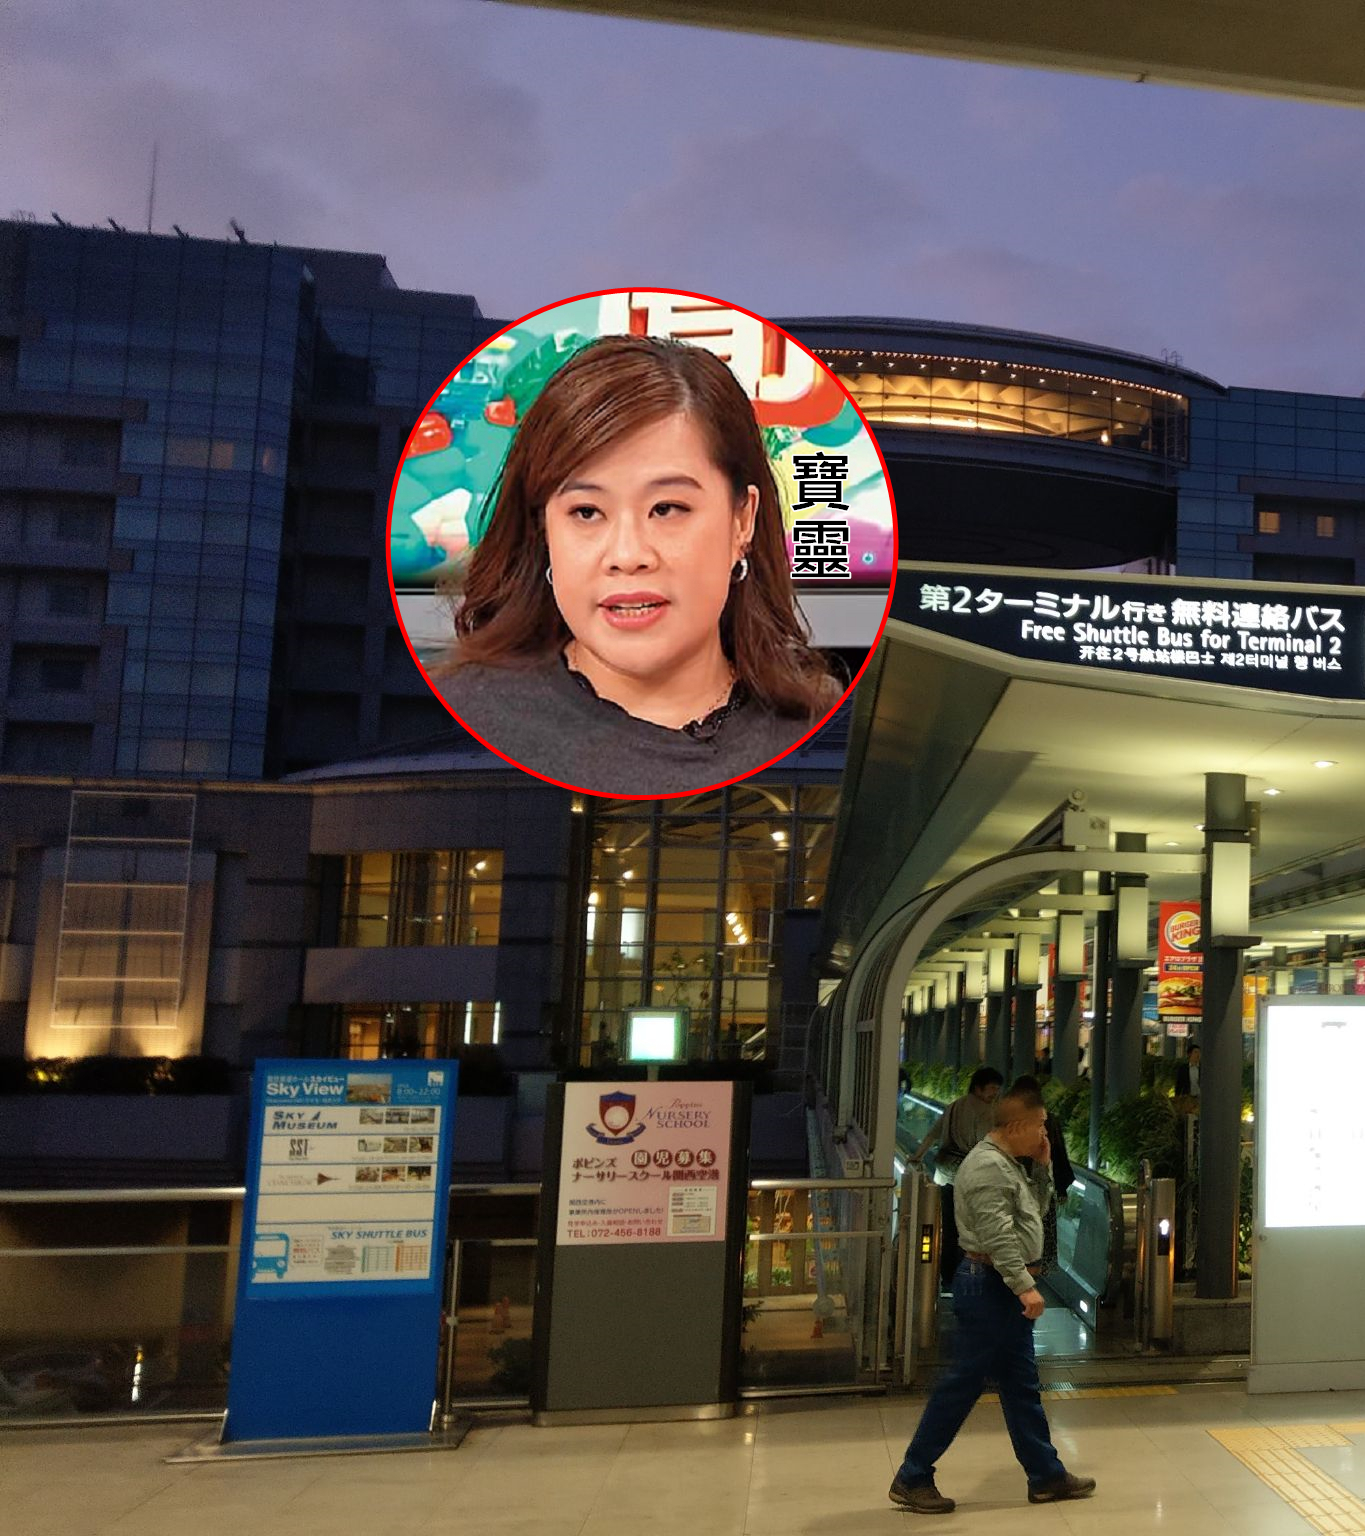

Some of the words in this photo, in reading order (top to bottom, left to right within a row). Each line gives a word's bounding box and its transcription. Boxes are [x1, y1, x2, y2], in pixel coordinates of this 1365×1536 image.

[1021, 620, 1065, 641] Free
[1073, 622, 1149, 645] Shuttle
[1157, 627, 1193, 648] Bus
[1200, 629, 1231, 649] for
[1238, 630, 1321, 655] Terminal
[1329, 636, 1341, 655] 2
[1171, 919, 1200, 933] BURGER
[1171, 927, 1201, 942] KING
[267, 1083, 300, 1097] Sky
[303, 1083, 343, 1095] View
[273, 1111, 303, 1120] SKY
[641, 1107, 710, 1121] NURSERY
[272, 1121, 337, 1130] MUSEUM
[657, 1120, 710, 1128] SCHOOL
[633, 1151, 714, 1167] 園児募集
[331, 1230, 353, 1239] SKY
[356, 1230, 403, 1239] SHUTTLE
[406, 1229, 428, 1238] BUS
